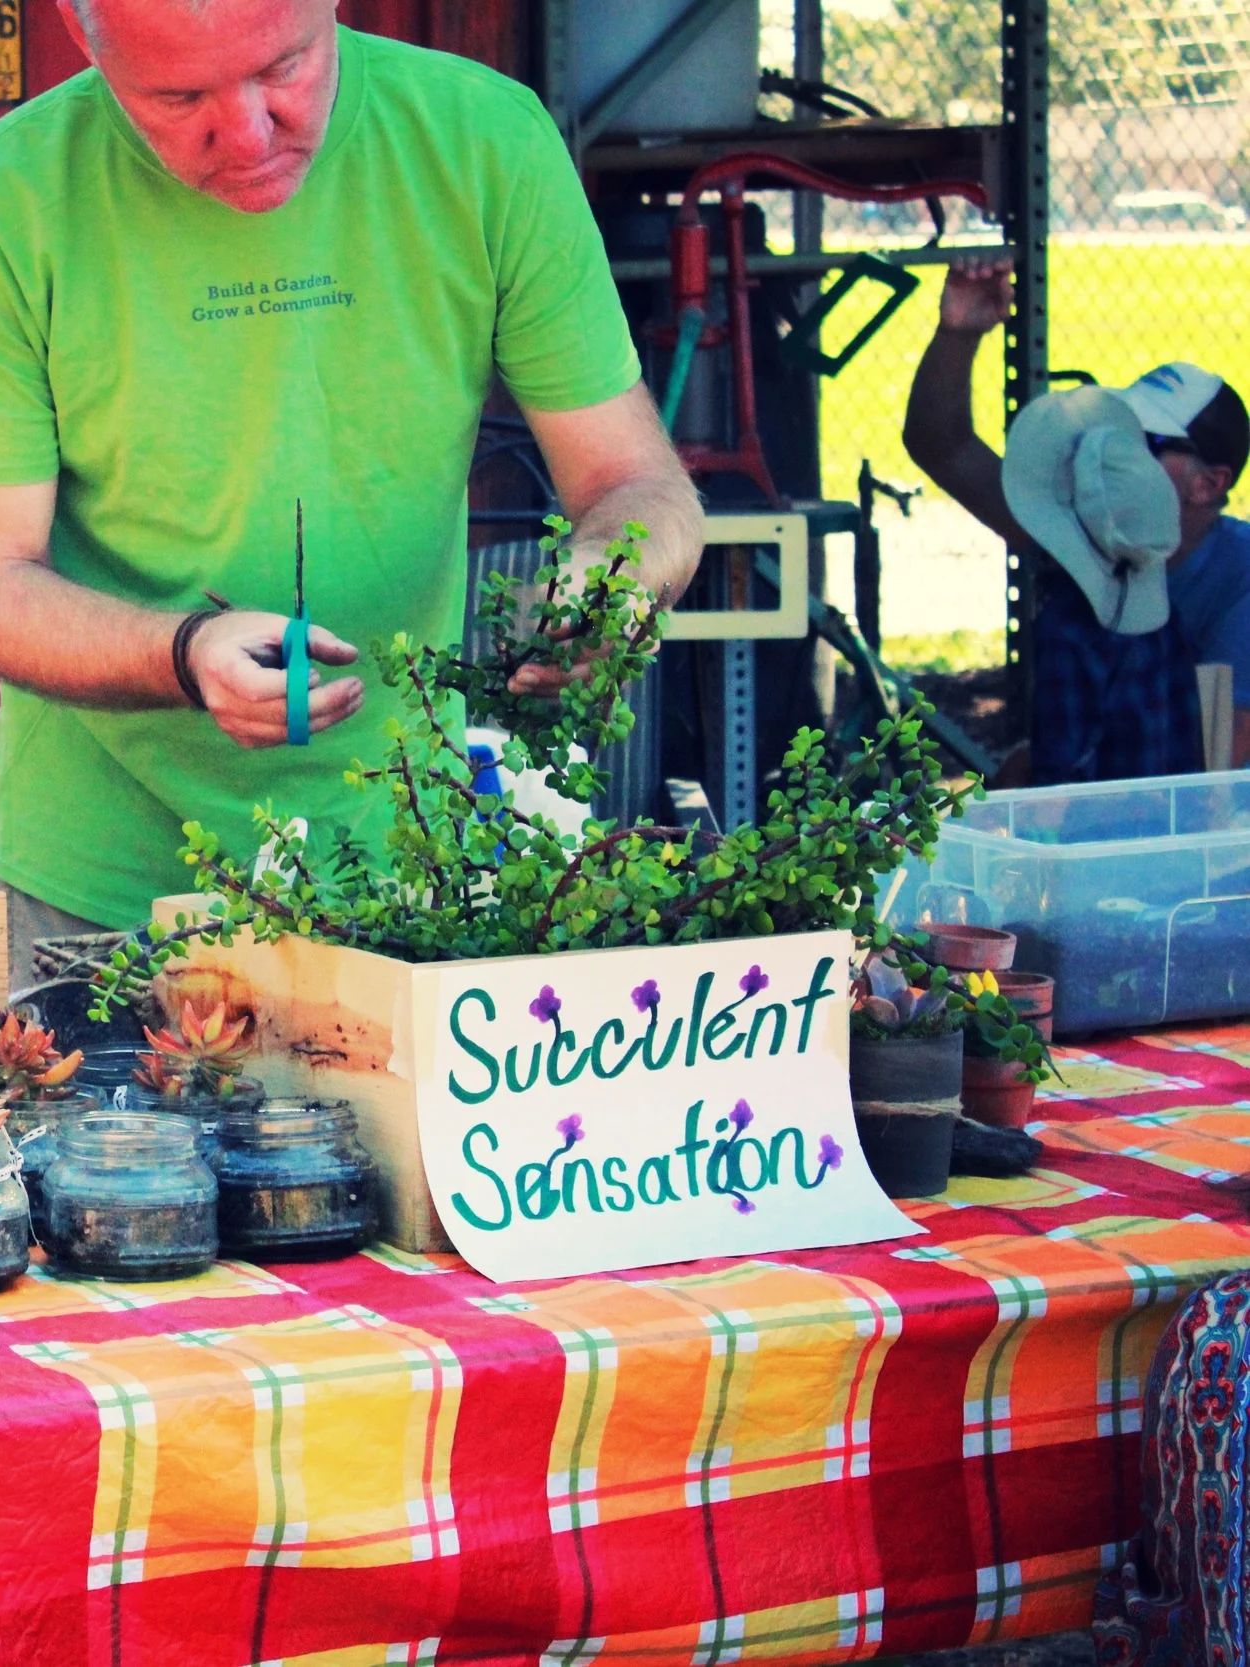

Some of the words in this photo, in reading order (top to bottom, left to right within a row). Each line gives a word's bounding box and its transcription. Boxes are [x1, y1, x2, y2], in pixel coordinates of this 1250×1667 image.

[208, 281, 255, 300] Build
[260, 284, 270, 294] a
[274, 274, 338, 293] Garden.
[192, 305, 240, 322] Grow
[245, 305, 255, 316] a
[259, 290, 357, 314] Community.
[447, 956, 835, 1105] Succulent
